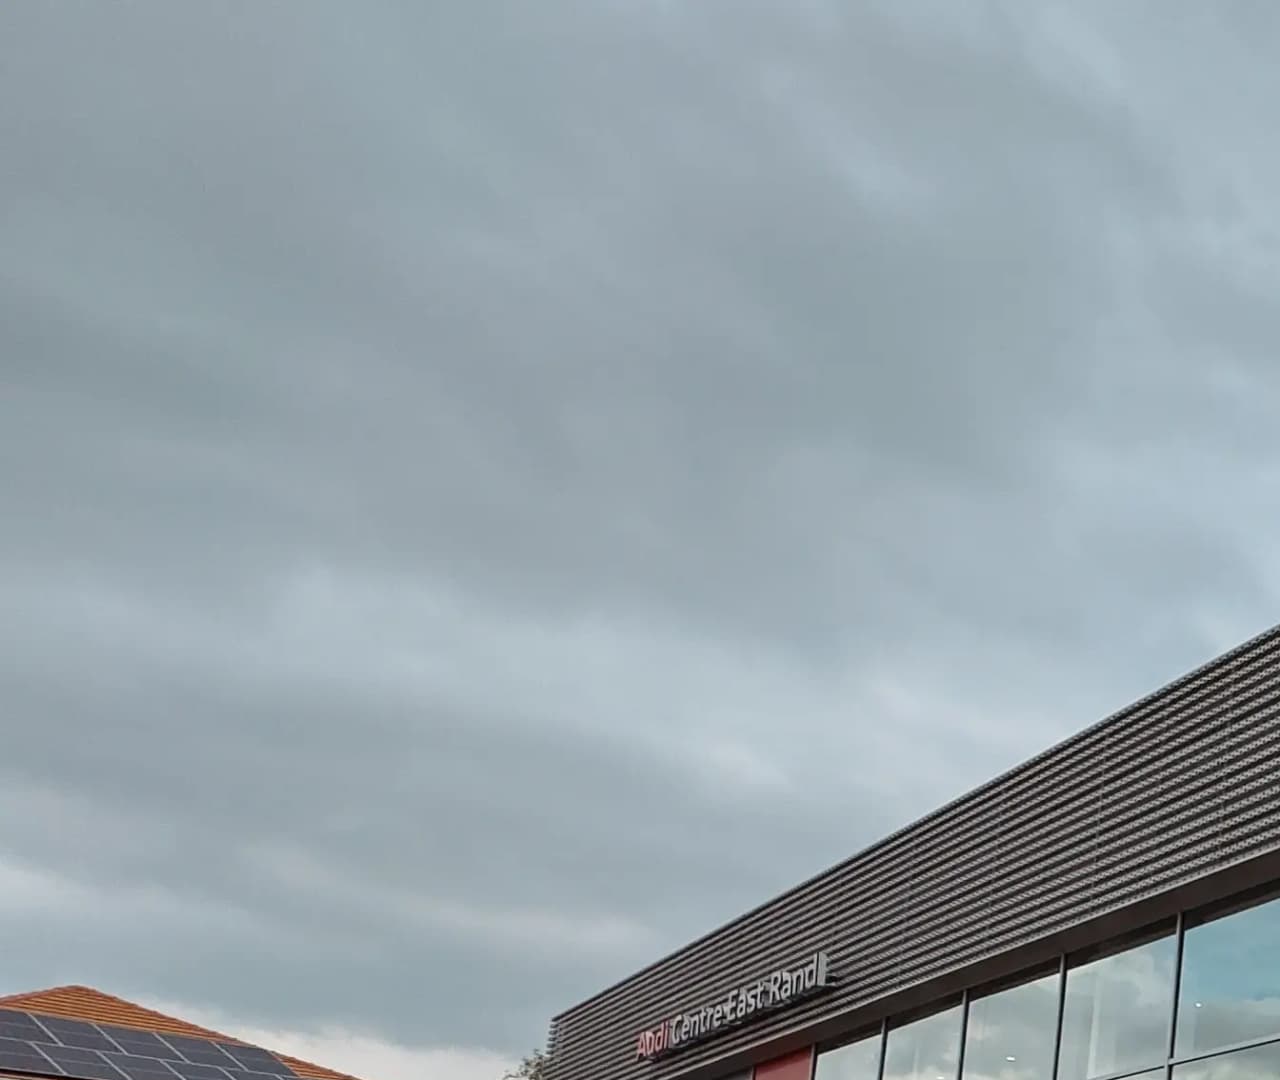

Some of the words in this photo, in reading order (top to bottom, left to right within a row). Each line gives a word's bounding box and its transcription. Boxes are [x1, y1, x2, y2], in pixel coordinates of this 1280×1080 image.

[635, 1020, 669, 1061] Audi
[671, 1003, 723, 1044] Centre
[726, 983, 766, 1021] East
[769, 951, 826, 1002] Rand
